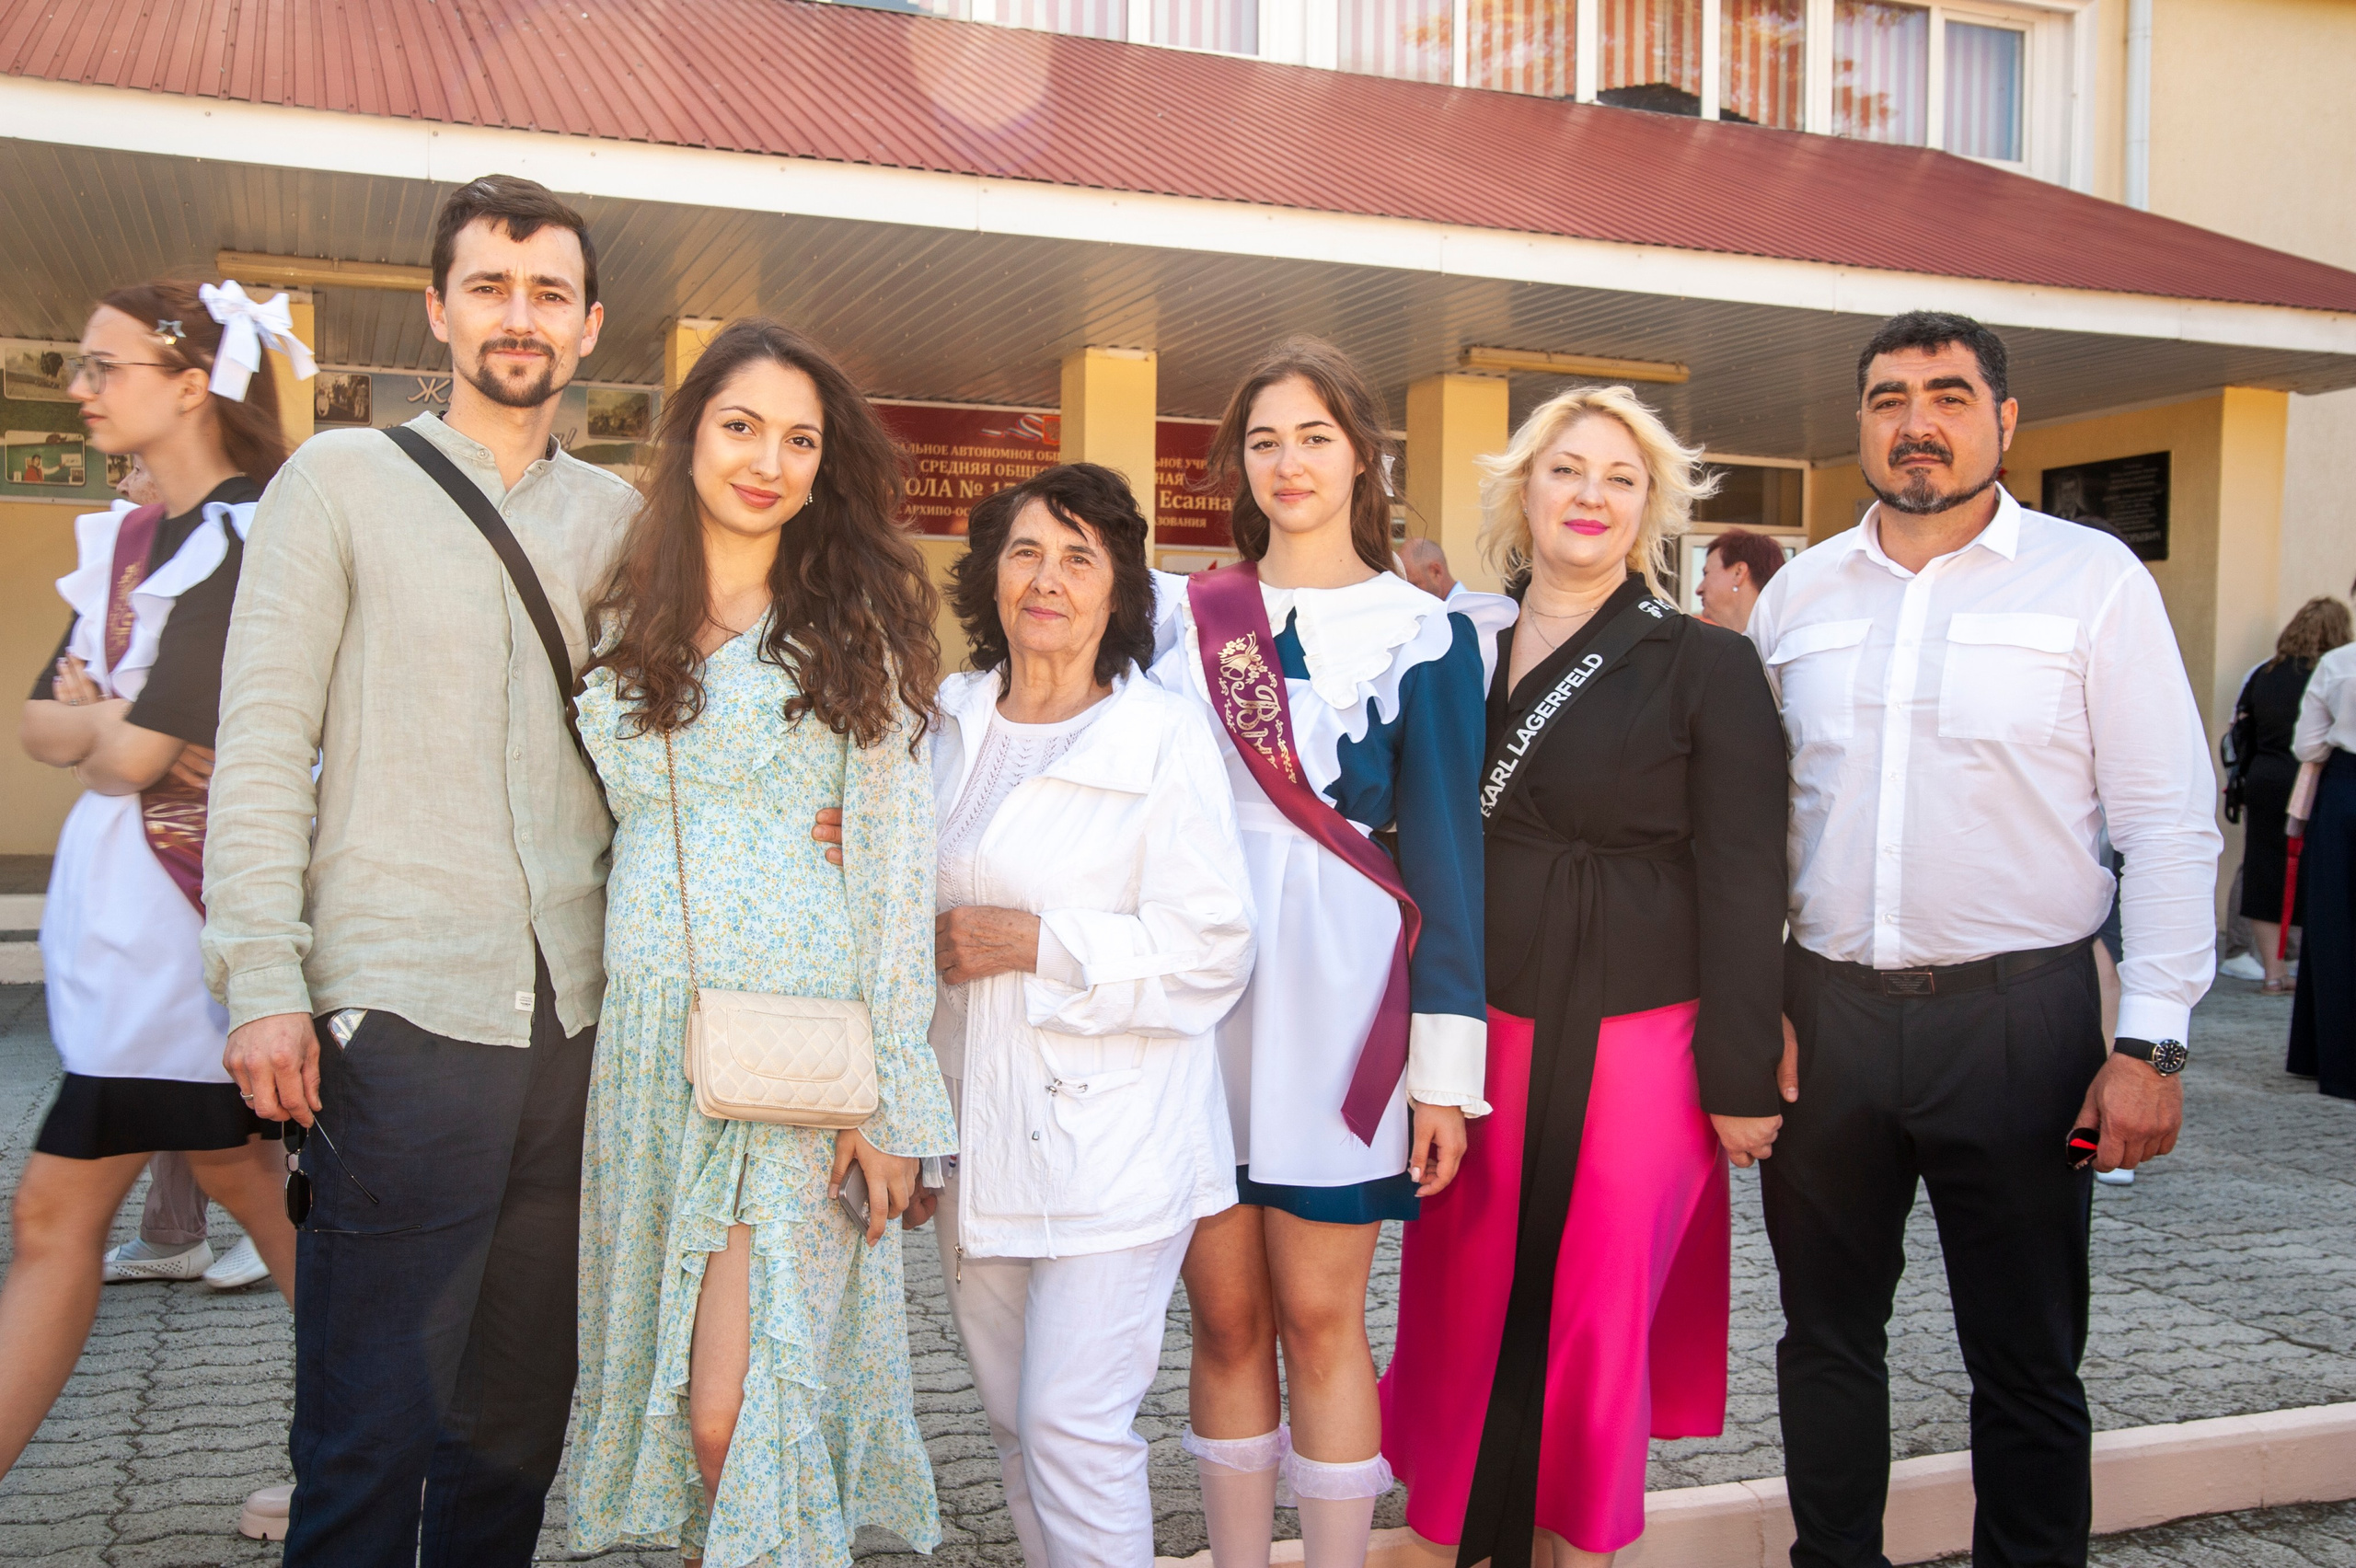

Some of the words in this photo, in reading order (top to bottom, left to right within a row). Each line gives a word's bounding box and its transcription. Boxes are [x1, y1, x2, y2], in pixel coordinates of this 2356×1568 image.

[951, 445, 1034, 461] АВТОНОМНОЕ
[920, 459, 991, 477] СРЕДНЯЯ
[904, 478, 953, 498] ОЛА
[959, 479, 984, 498] №
[1160, 490, 1232, 511] Есаяна
[1480, 758, 1519, 818] KARL
[1507, 653, 1603, 756] LAGERFELD
